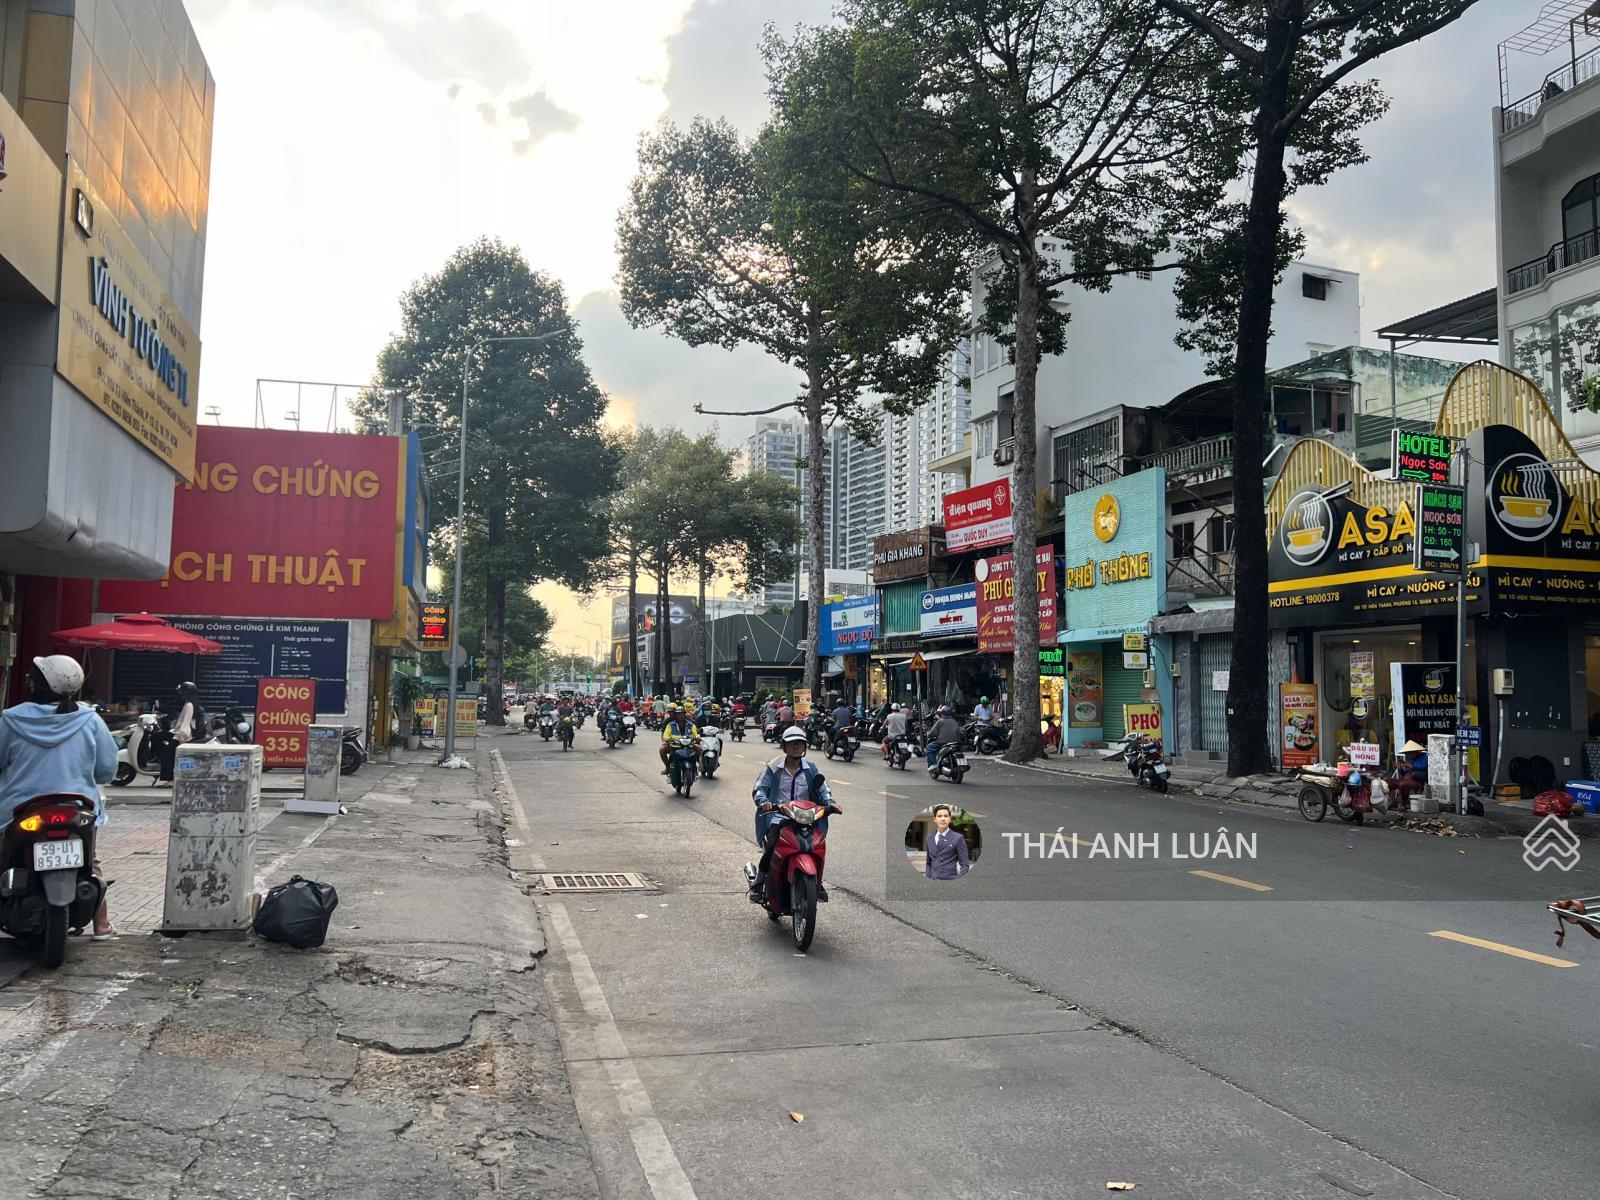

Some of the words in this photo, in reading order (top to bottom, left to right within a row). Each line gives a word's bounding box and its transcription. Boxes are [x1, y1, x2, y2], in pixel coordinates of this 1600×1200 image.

[1400, 434, 1448, 458] HOTEL
[1402, 455, 1426, 468] Ngọc
[1428, 458, 1447, 471] Sơn
[177, 462, 239, 492] NG
[253, 459, 380, 499] CHỨNG
[1432, 472, 1446, 481] 50m
[946, 504, 966, 516] điện
[968, 498, 992, 516] quang
[1424, 490, 1447, 508] KHÁCH
[1448, 495, 1462, 512] SẠN
[1424, 511, 1446, 526] NGỌC
[1446, 512, 1462, 526] SƠN
[978, 528, 988, 541] DUY
[1424, 526, 1436, 535] 1H:
[1438, 527, 1447, 536] 50
[1454, 528, 1462, 537] 70
[1440, 538, 1452, 546] 160
[1562, 538, 1572, 549] MÌ
[1576, 540, 1591, 550] CAY
[887, 550, 898, 562] GIA
[900, 544, 923, 560] KHANG
[1339, 551, 1348, 562] MÌ
[1350, 550, 1364, 560] CAY
[1366, 549, 1371, 558] 7
[1374, 543, 1389, 556] CẤP
[247, 548, 366, 592] THUẬT
[1066, 557, 1096, 590] PHỞ
[1100, 551, 1152, 584] THÔNG
[982, 574, 1002, 601] PHÚ
[1367, 584, 1378, 598] MÌ
[1380, 585, 1397, 596] CAY
[1407, 578, 1446, 594] NƯỚNG
[1498, 572, 1510, 586] MÌ
[1513, 577, 1533, 588] CAY
[1546, 575, 1586, 590] NƯỚNG
[1270, 596, 1304, 608] HOTLINE:
[1306, 592, 1340, 606] 19000378
[206, 622, 232, 630] CÔNG
[234, 623, 264, 632] CHỨNG
[266, 624, 274, 632] LÊ
[264, 683, 310, 700] CÔNG
[1408, 692, 1416, 704] MÌ
[1420, 694, 1436, 704] CAY
[258, 709, 312, 726] CHỨNG
[1131, 706, 1160, 730] PHỞ
[1420, 721, 1432, 729] DUY
[1434, 718, 1450, 728] NHẤT
[1468, 730, 1480, 739] 286
[266, 736, 300, 752] 335
[38, 854, 80, 868] 853.42
